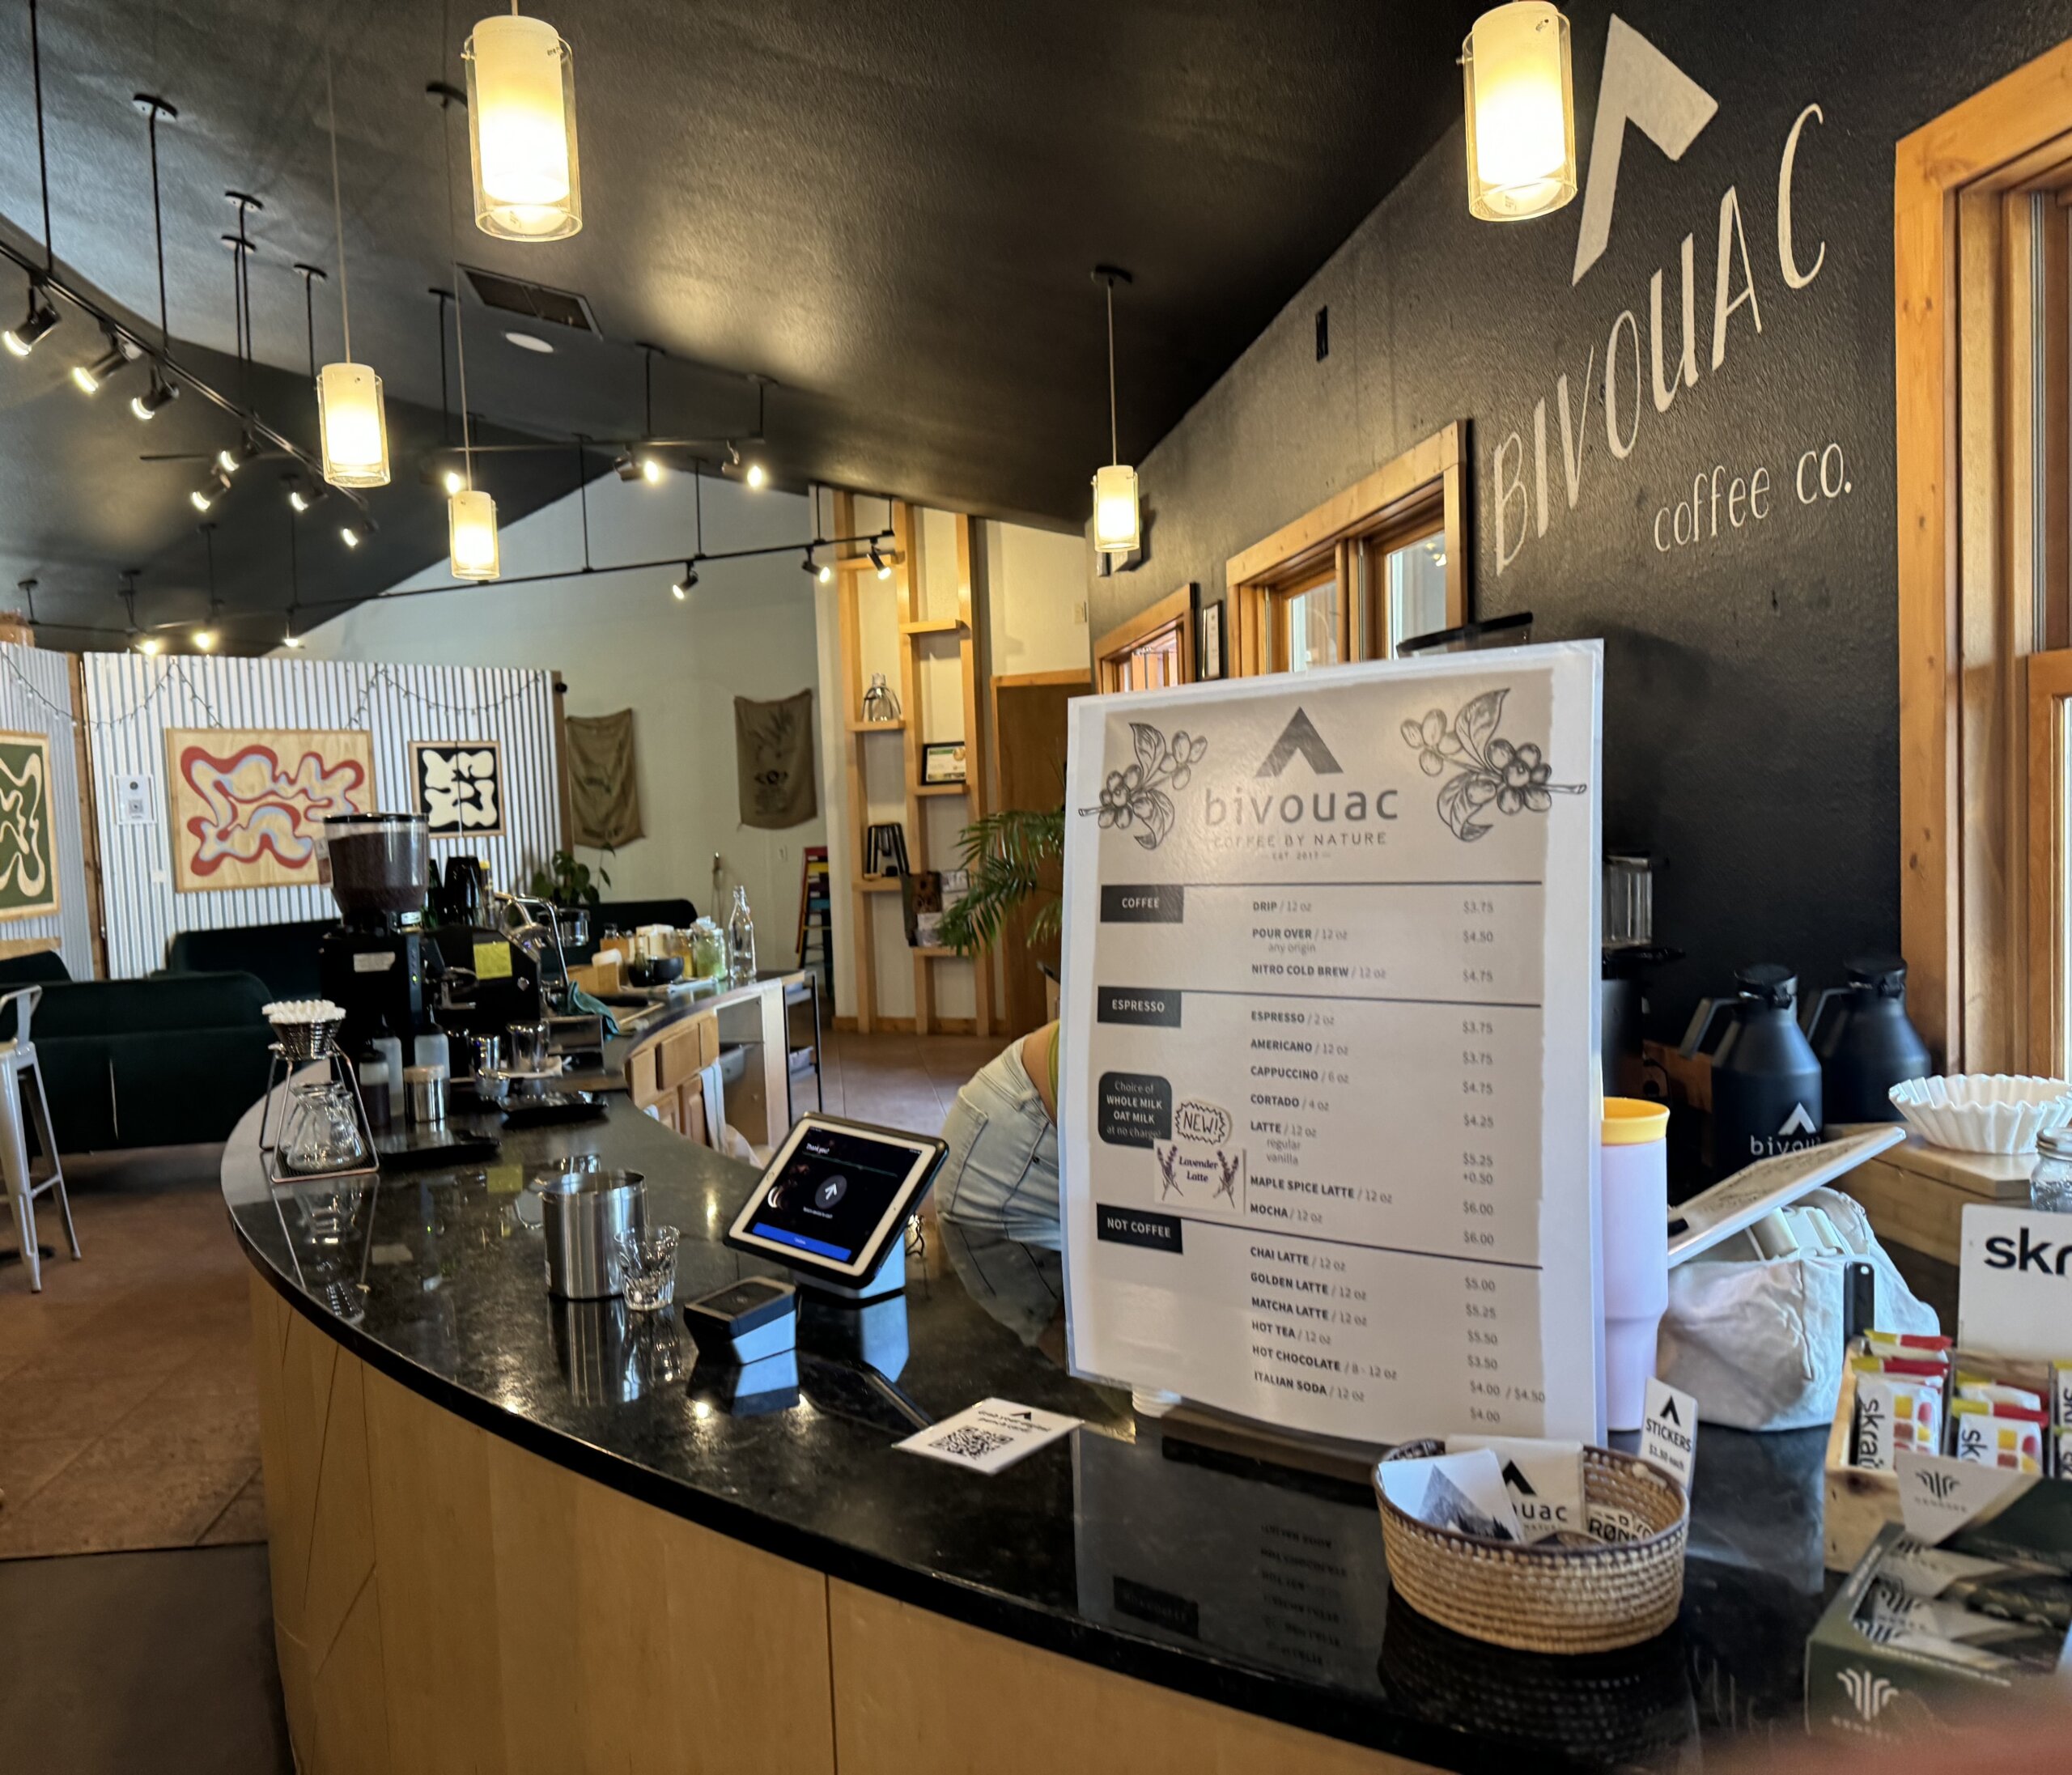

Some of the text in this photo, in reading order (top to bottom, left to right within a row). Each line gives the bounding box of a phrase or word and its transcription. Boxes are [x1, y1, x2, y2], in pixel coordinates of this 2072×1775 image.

[1493, 103, 1825, 576] BIVOUAC
[1654, 465, 1770, 552] coffee
[1204, 786, 1399, 826] bivouac
[1214, 831, 1387, 848] COFFEE BY NATURE
[1122, 897, 1160, 909] COFFEE
[1253, 901, 1277, 911] DRIP
[1252, 928, 1281, 939] POUR
[1284, 929, 1312, 939] OVER
[1323, 930, 1333, 940] 12
[1268, 941, 1316, 954] any origin
[1252, 964, 1284, 975] NITRO
[1287, 965, 1314, 976] COLD
[1318, 966, 1349, 978] BREW
[1111, 999, 1166, 1013] ESPRESSO
[1250, 1011, 1306, 1024] ESPRESSO
[1250, 1039, 1313, 1053] AMERICANO
[1250, 1065, 1319, 1081] CAPPUCCINO
[1115, 1080, 1154, 1093] Choice of
[1106, 1094, 1163, 1110] WHOLE MILK
[1250, 1093, 1300, 1107] CORTADO
[1114, 1110, 1155, 1124] OAT MILK
[1182, 1111, 1219, 1135] NEW!
[1250, 1120, 1281, 1134] LATTE
[1267, 1137, 1301, 1151] regular
[1178, 1156, 1219, 1170] Lavender
[1266, 1152, 1299, 1166] vanilla
[1187, 1170, 1209, 1183] Latte
[1250, 1175, 1284, 1191] MAPLE
[1287, 1179, 1318, 1195] SPICE
[1321, 1184, 1354, 1199] LATTE
[1365, 1189, 1377, 1202] 12
[1250, 1203, 1289, 1218] MOCHA
[1297, 1210, 1309, 1222] 12
[1106, 1217, 1172, 1239] NOT COFFEE
[1250, 1246, 1275, 1260] CHAI
[1277, 1251, 1309, 1266] LATTE
[1320, 1257, 1331, 1269] 12
[1250, 1272, 1293, 1289] GOLDEN
[1296, 1280, 1328, 1295] LATTE
[1340, 1286, 1351, 1299] 12
[1251, 1296, 1293, 1314] MATCHA
[1296, 1305, 1328, 1321] LATTE
[1340, 1311, 1352, 1325] 12
[1251, 1319, 1273, 1334] HOT
[1276, 1325, 1296, 1339] TEA
[1252, 1344, 1273, 1359] HOT
[1276, 1350, 1341, 1371] CHOCOLATE
[1254, 1370, 1293, 1389] ITALIAN
[1297, 1380, 1327, 1396] SODA
[1645, 1417, 1692, 1453] STICKERS
